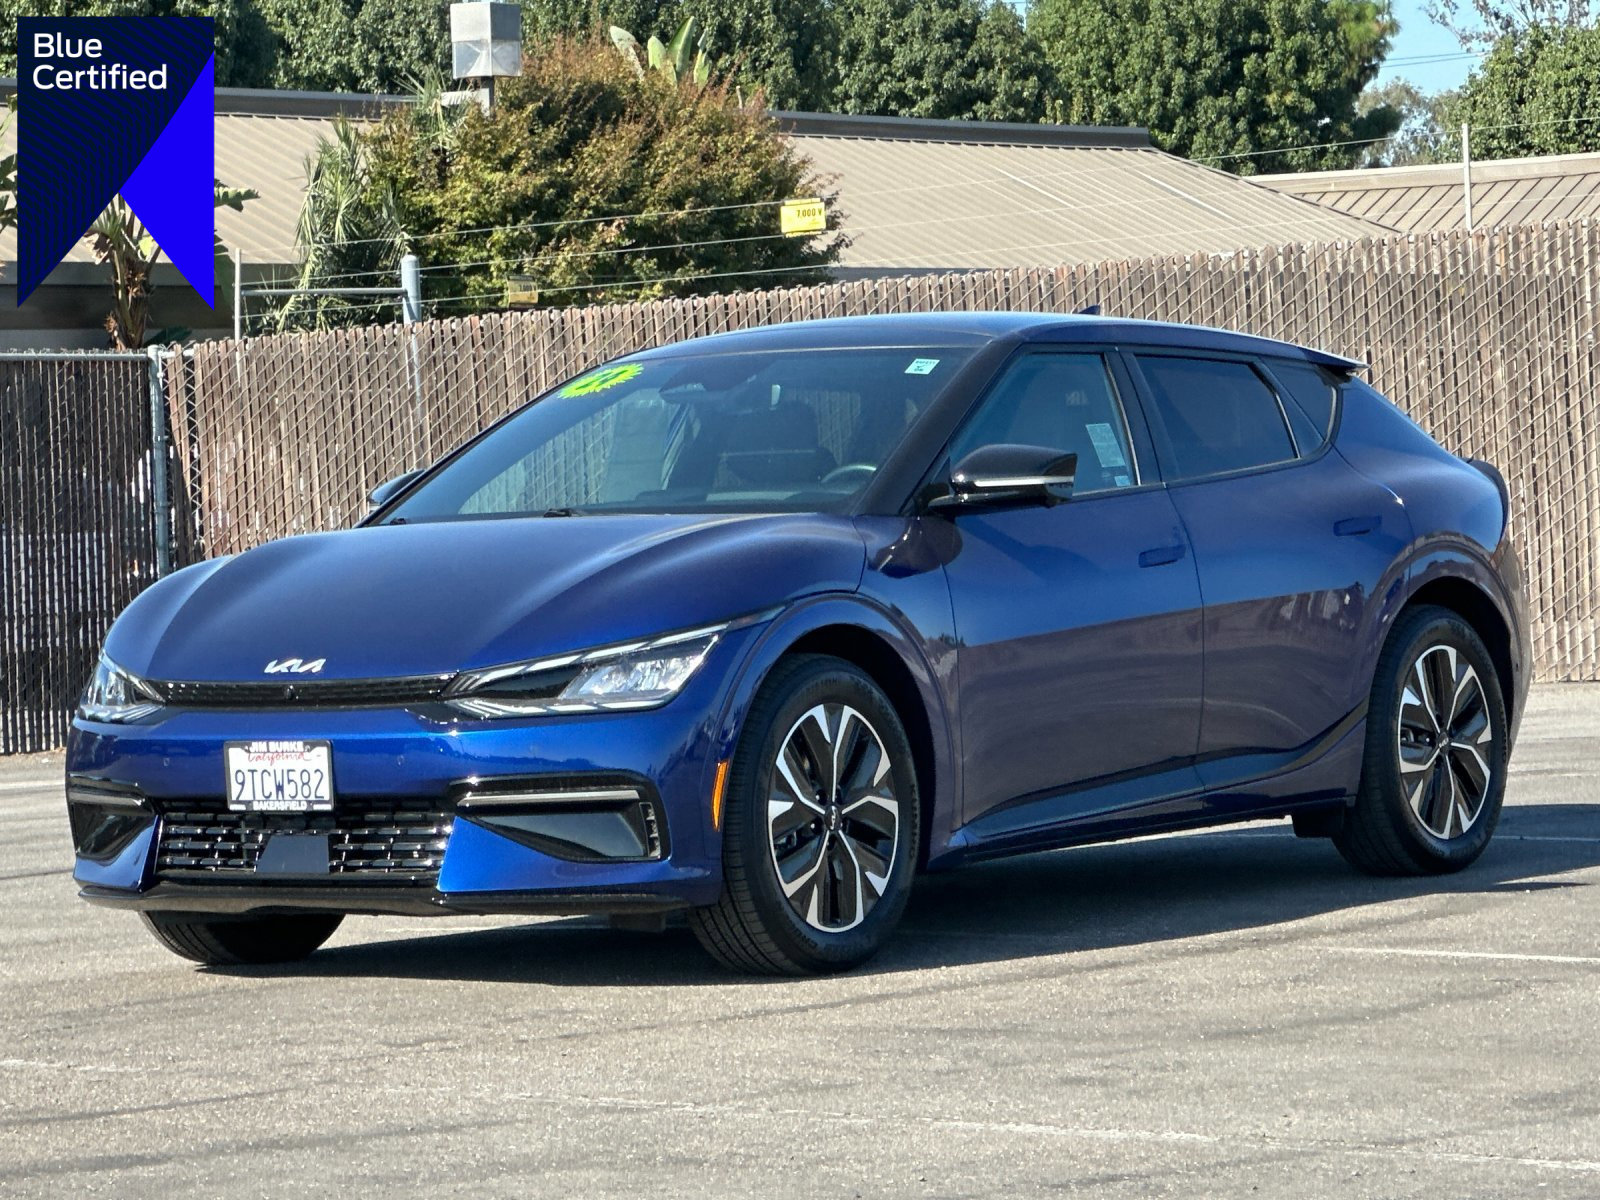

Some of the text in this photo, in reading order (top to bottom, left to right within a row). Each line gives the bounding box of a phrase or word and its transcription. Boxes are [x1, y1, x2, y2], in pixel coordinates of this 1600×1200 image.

[264, 658, 326, 674] KIA
[249, 741, 268, 753] JIM
[247, 751, 306, 766] California
[235, 768, 325, 802] 9TCW582
[252, 800, 308, 811] BAKERSFIELD
